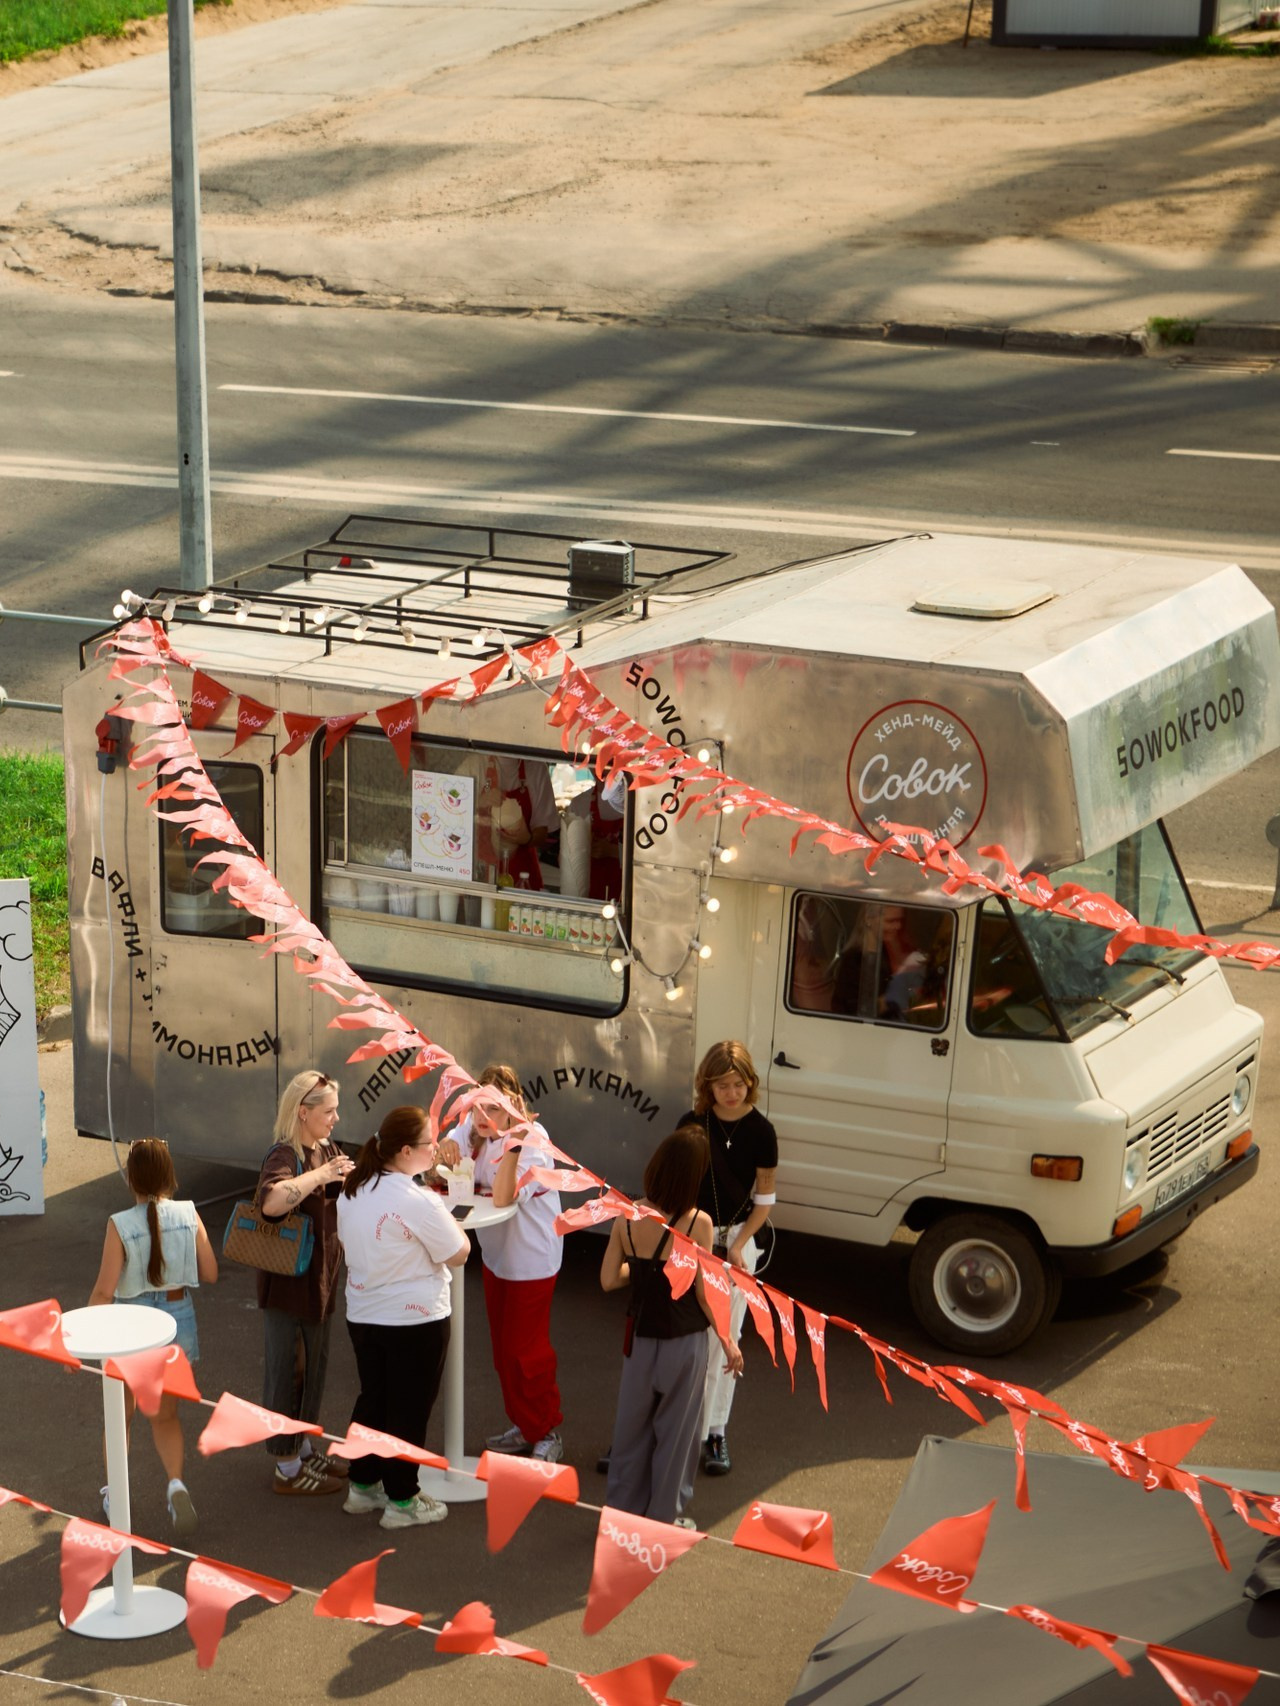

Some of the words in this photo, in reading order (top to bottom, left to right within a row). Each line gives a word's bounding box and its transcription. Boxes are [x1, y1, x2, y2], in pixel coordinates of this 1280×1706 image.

[191, 691, 217, 710] Совок
[238, 711, 265, 728] Совок
[387, 716, 412, 739] Совок
[874, 713, 962, 751] ХЕНД-МЕЙД
[858, 754, 971, 804] Совок
[413, 861, 454, 873] СПЕШЛ-МЕНЮ
[91, 856, 144, 958] ВАФЛИ
[358, 1030, 417, 1112] ЛАПШ
[553, 1067, 660, 1122] РУКАМИ
[896, 1554, 970, 1594] Совок
